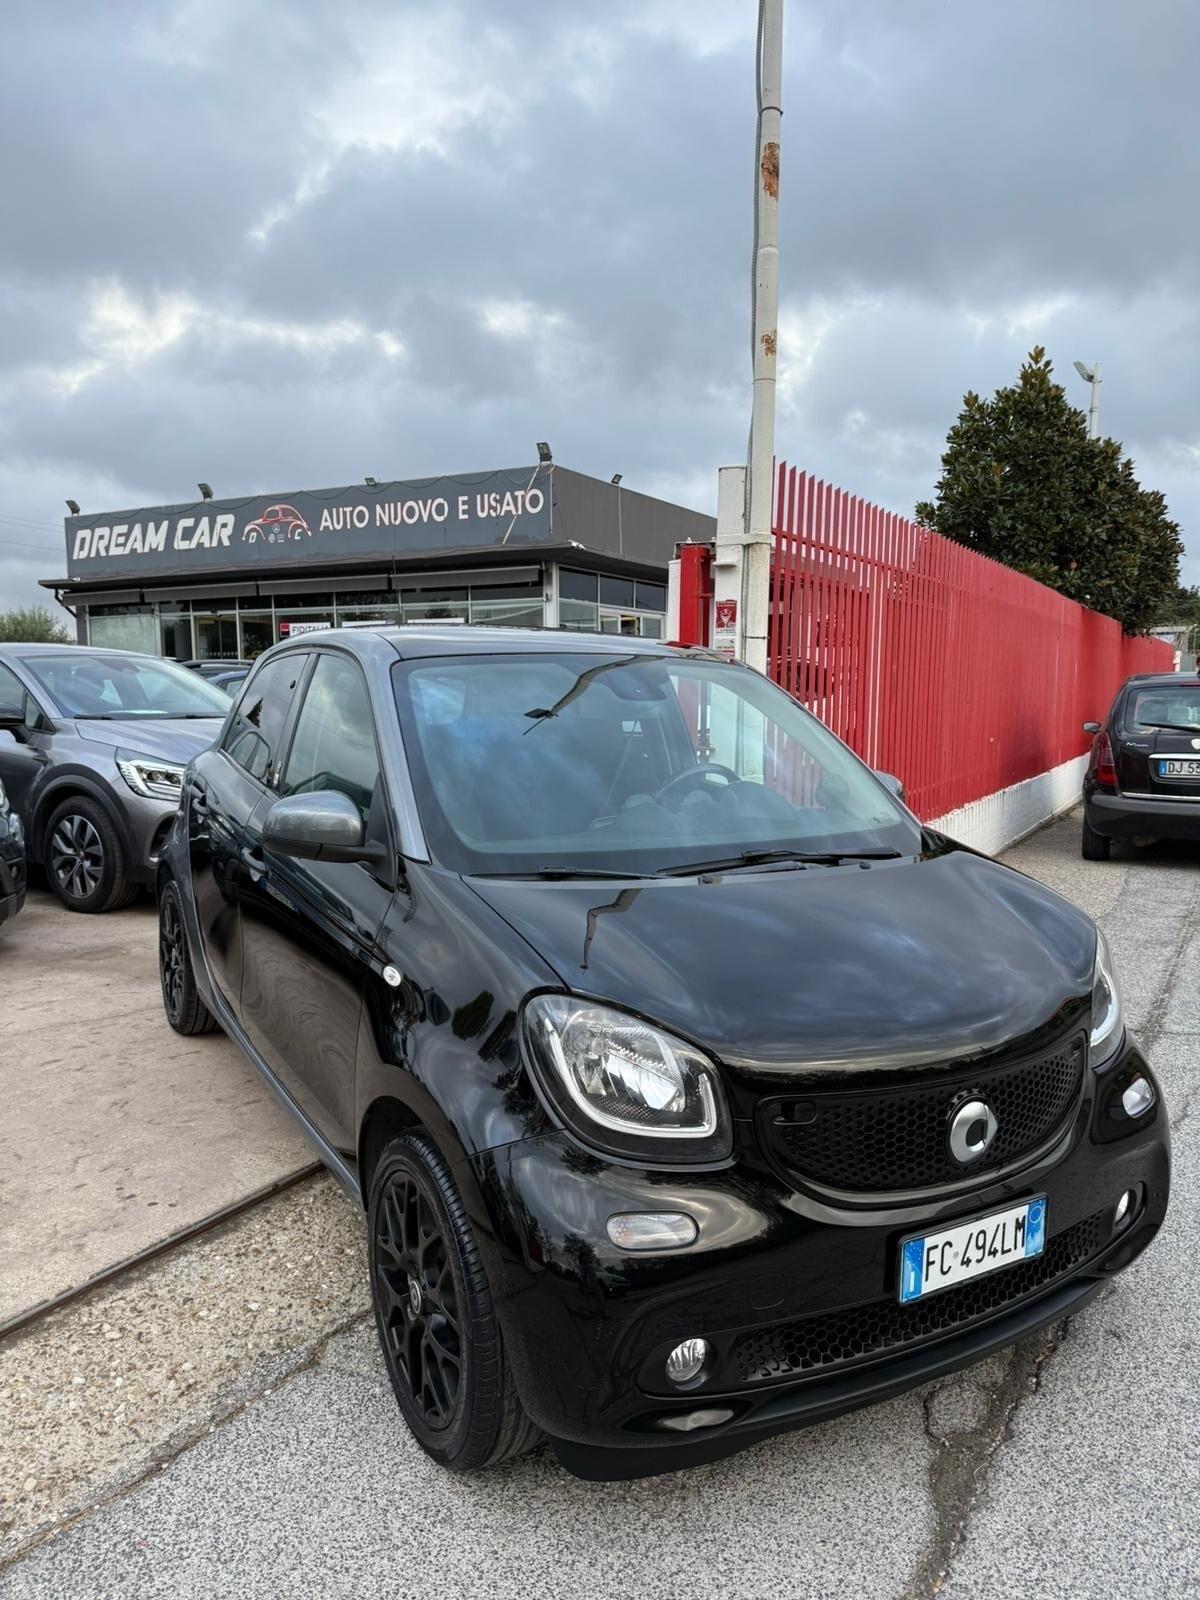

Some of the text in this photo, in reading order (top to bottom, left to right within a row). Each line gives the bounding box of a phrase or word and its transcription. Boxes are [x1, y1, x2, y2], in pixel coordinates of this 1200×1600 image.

[320, 488, 544, 532] AUTO NUOVO E USATO
[72, 513, 236, 560] DREAM CAR
[248, 531, 257, 544] D
[294, 528, 303, 540] C
